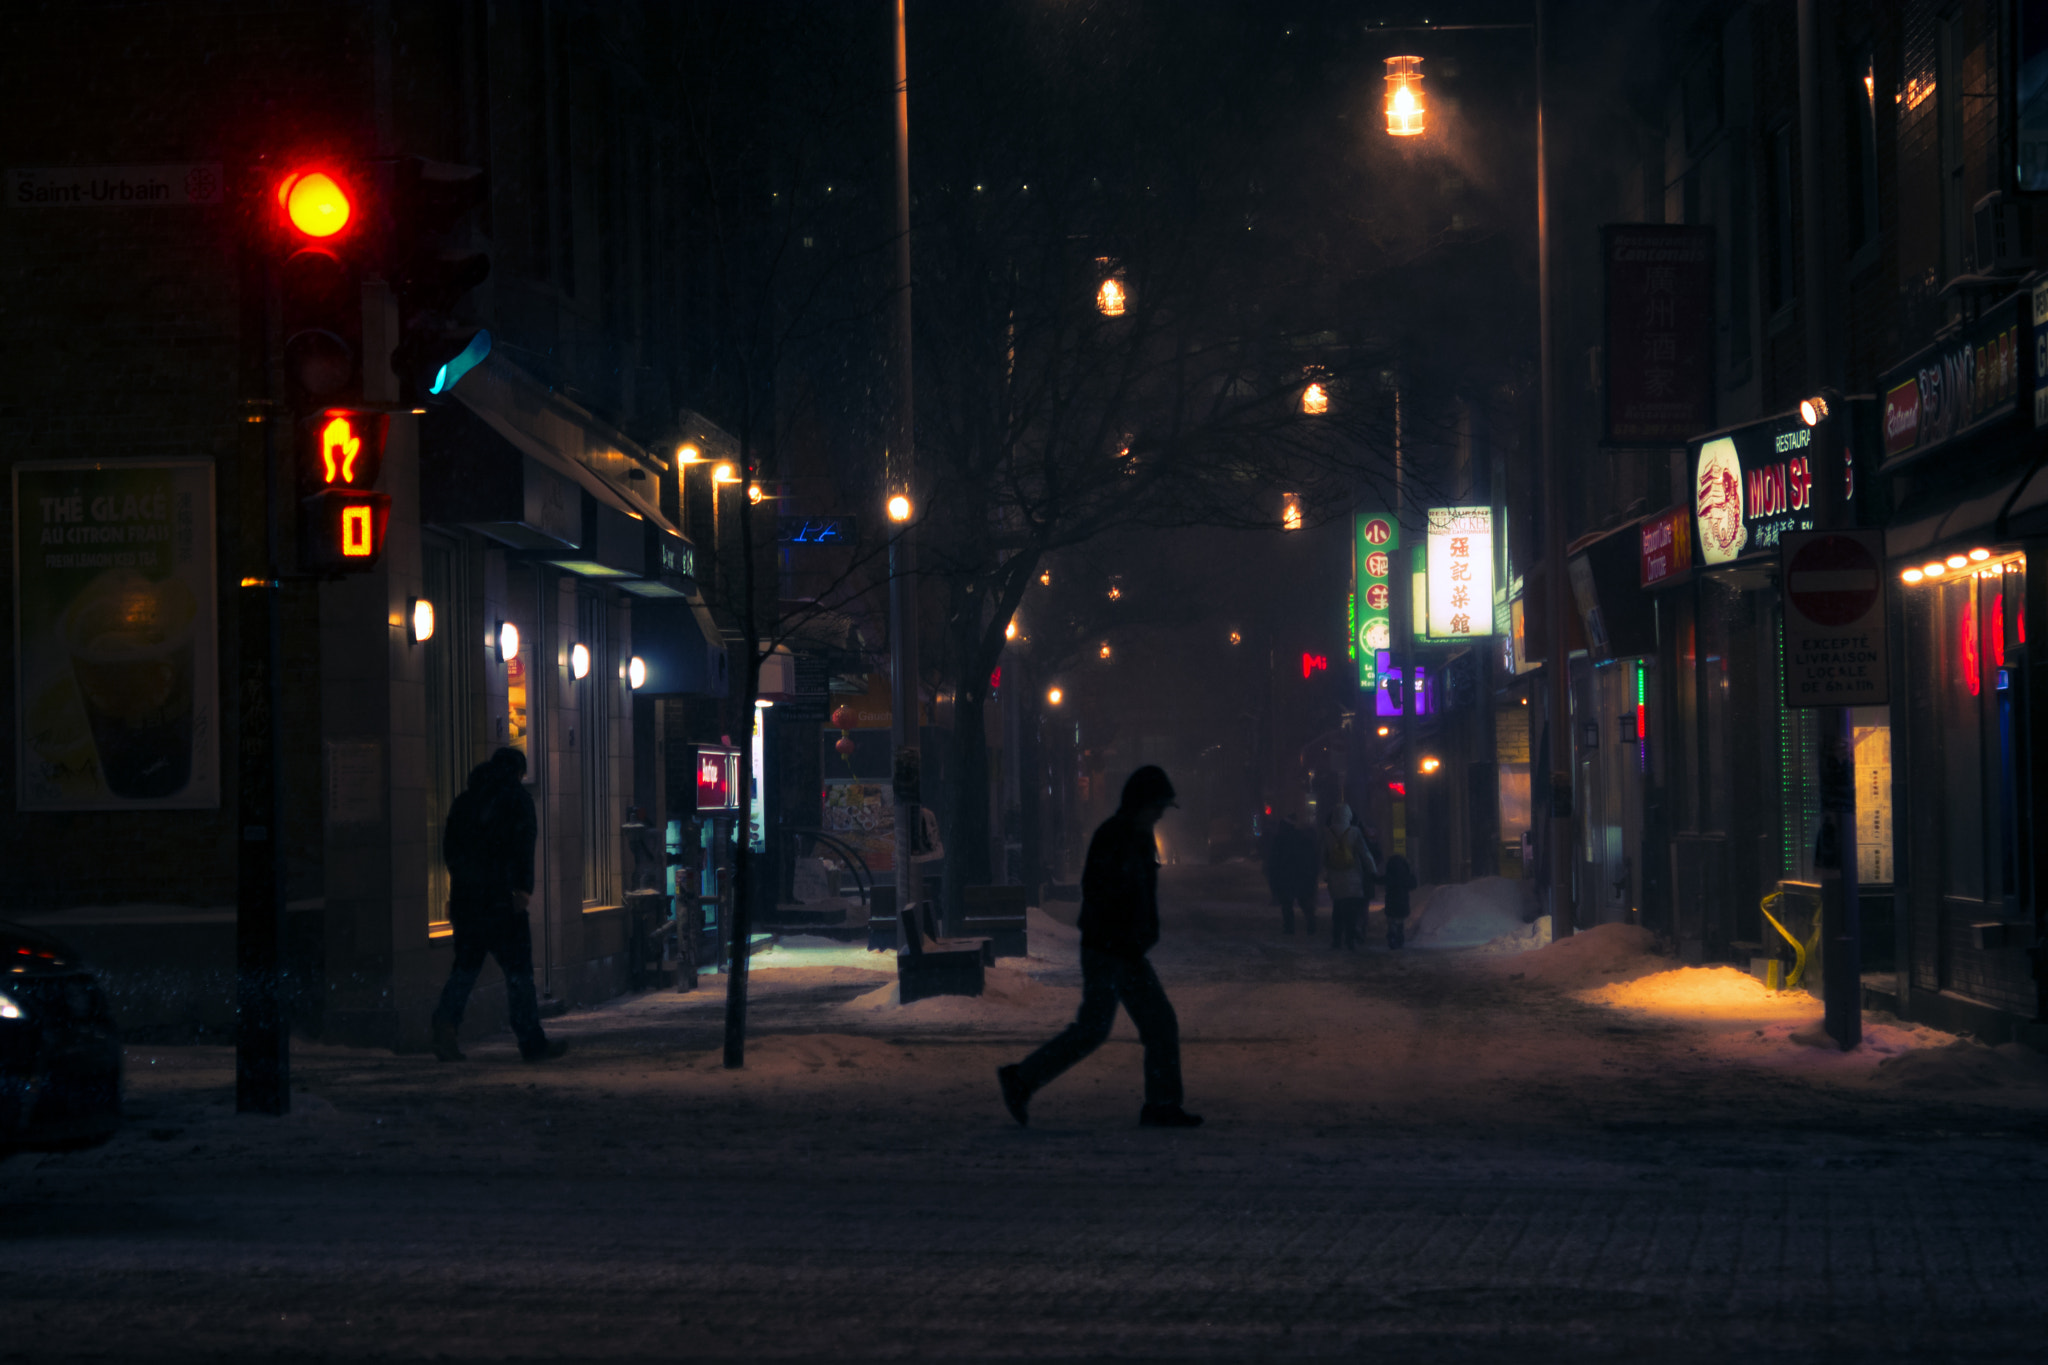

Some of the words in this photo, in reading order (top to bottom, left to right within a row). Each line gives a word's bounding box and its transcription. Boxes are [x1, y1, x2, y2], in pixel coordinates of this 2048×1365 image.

[17, 179, 169, 202] Saint-Urbain
[1614, 247, 1706, 262] Cantonais
[1643, 266, 1677, 398] 廣州酒家
[1776, 428, 1811, 453] RESTAURA
[1748, 462, 1787, 520] MON
[40, 487, 84, 523] THÉ
[91, 486, 167, 522] GLACÉ
[41, 526, 64, 545] AU
[66, 525, 124, 543] CITRON
[342, 505, 372, 556] 0
[75, 552, 112, 567] LEMON
[1802, 633, 1870, 650] EXCEPTÉ
[1796, 651, 1877, 665] LIVRAISON
[1807, 666, 1867, 679] LOCALE
[1801, 681, 1820, 692] DE
[858, 711, 893, 721] Gauch
